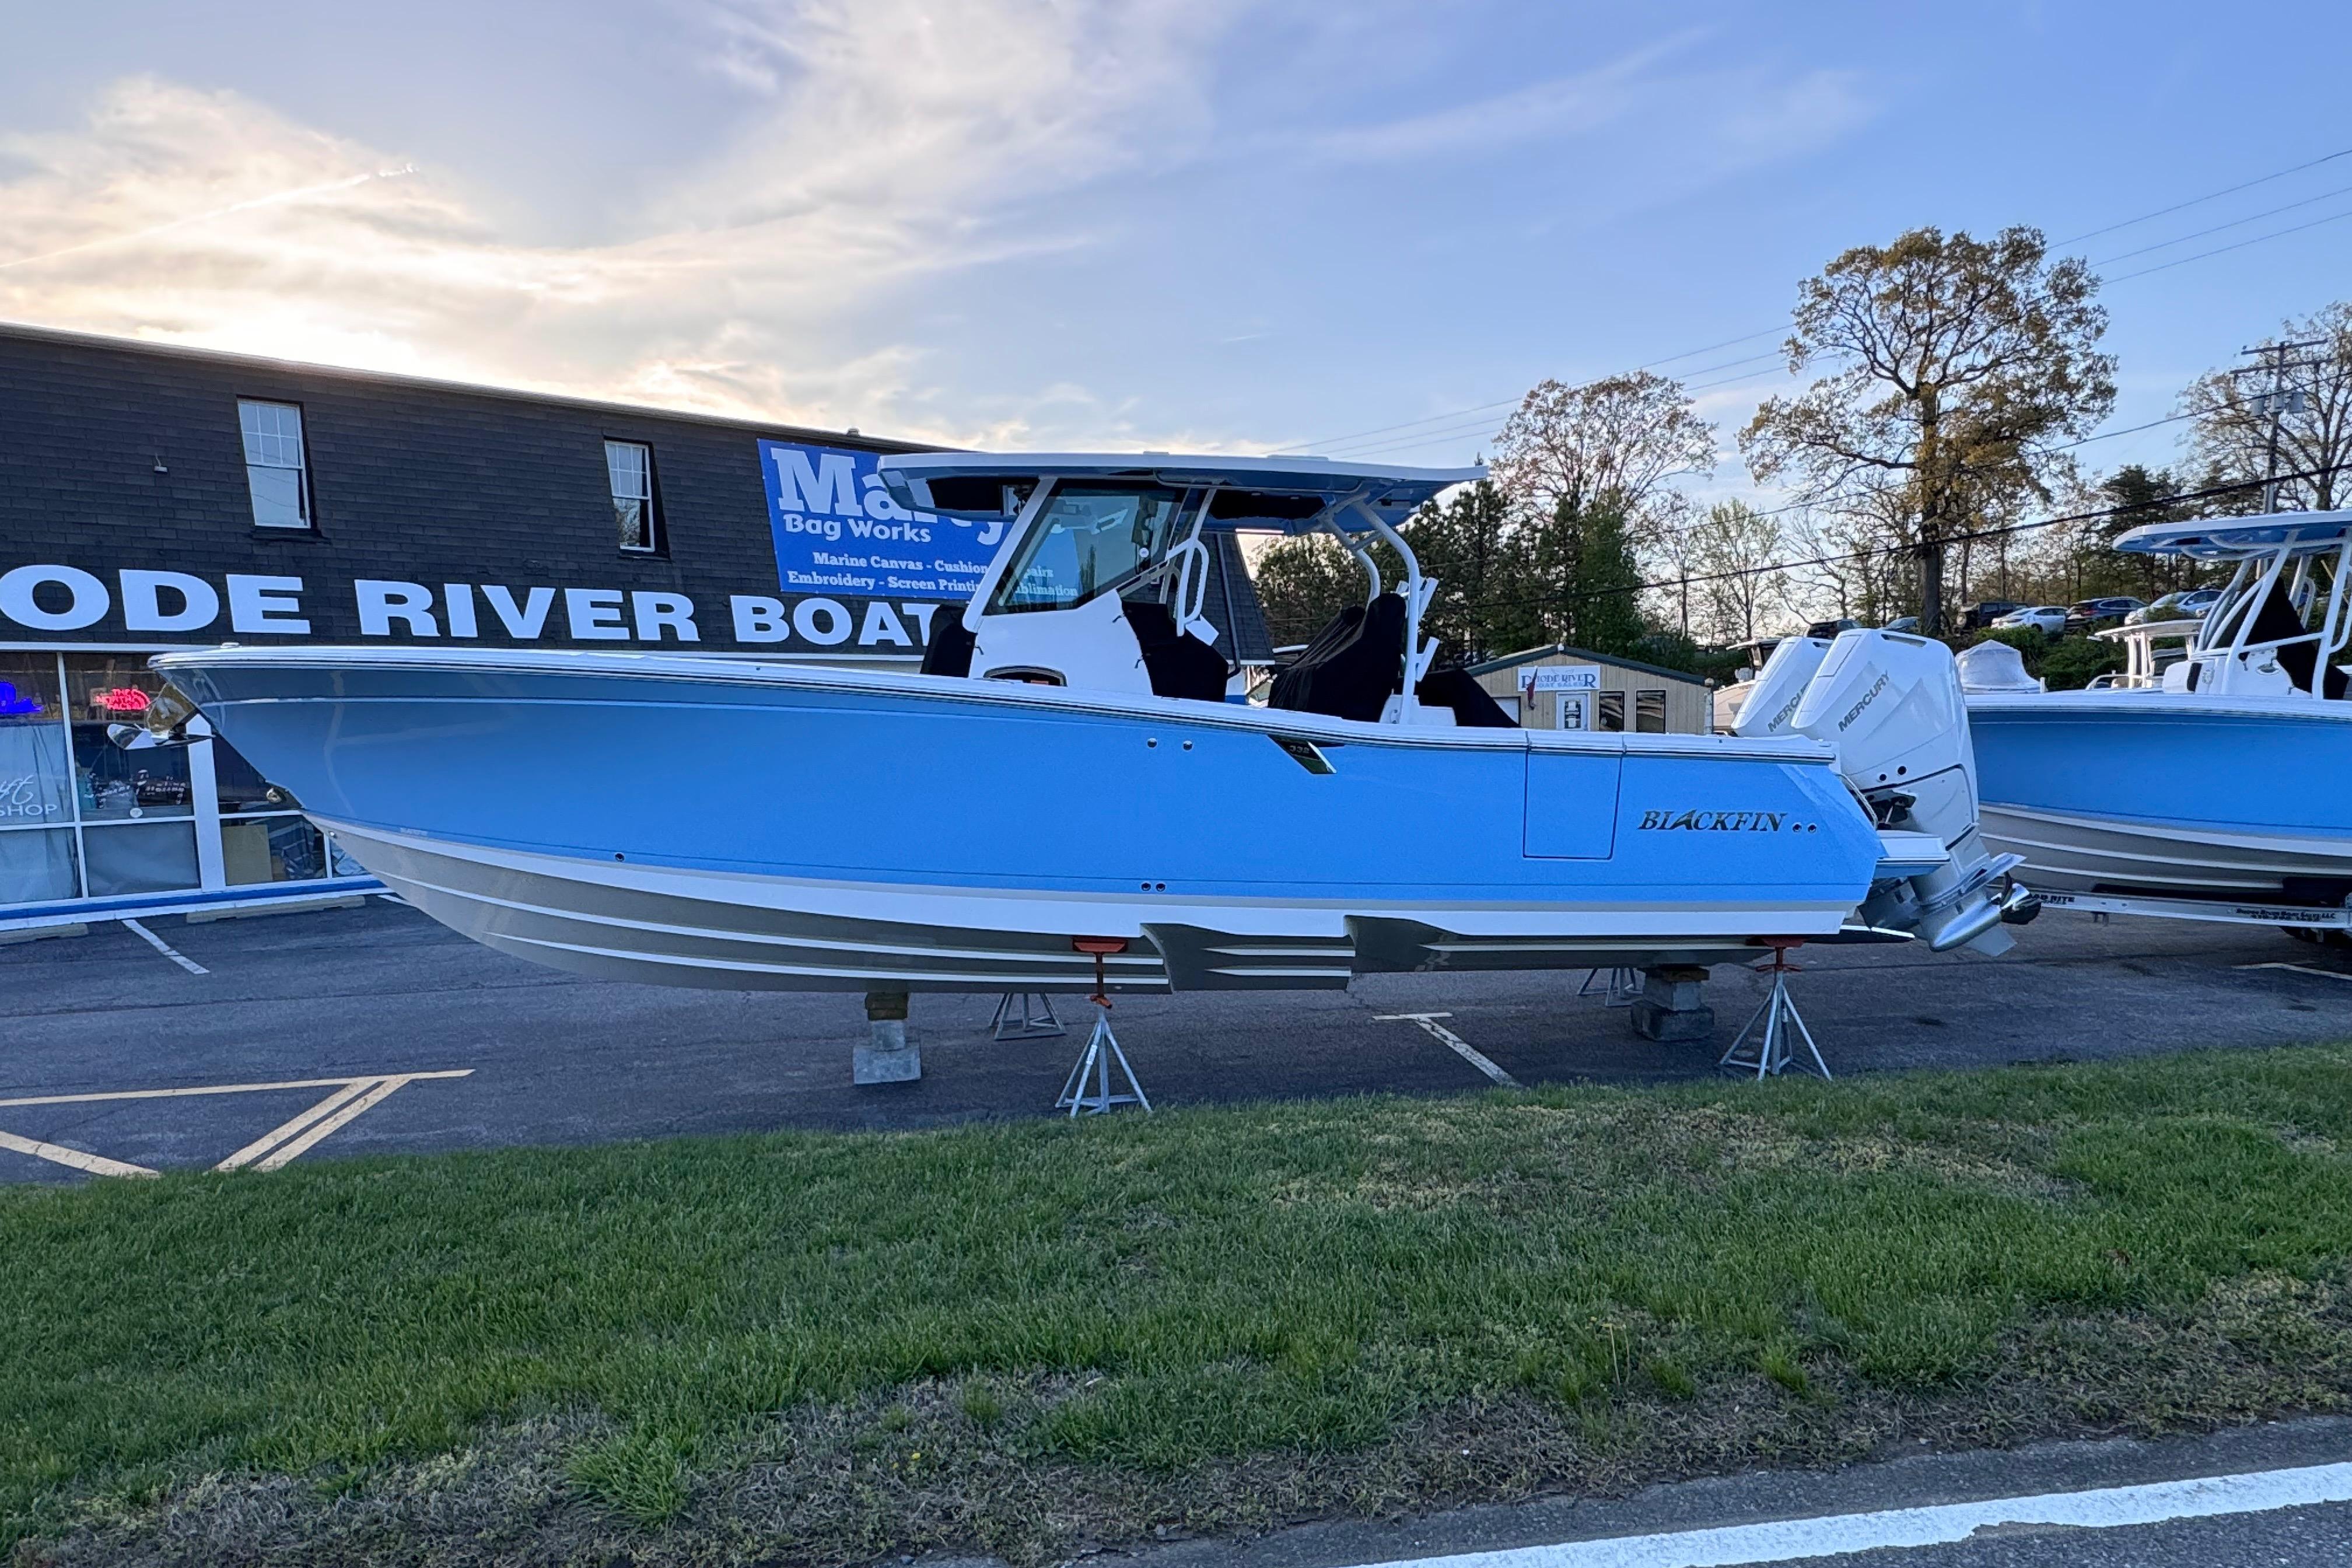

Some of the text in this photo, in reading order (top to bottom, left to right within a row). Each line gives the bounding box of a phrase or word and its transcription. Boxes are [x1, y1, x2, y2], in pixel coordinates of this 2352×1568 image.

[783, 514, 932, 543] Bag Works
[813, 552, 867, 567] Marine
[870, 555, 923, 570] Canvas
[788, 570, 876, 590] Embroidery
[887, 576, 936, 590] Screen
[0, 565, 940, 646] ODE RIVER BOAT
[1838, 669, 1889, 733] MERCURY
[1637, 808, 1788, 832] BLACKFIN
